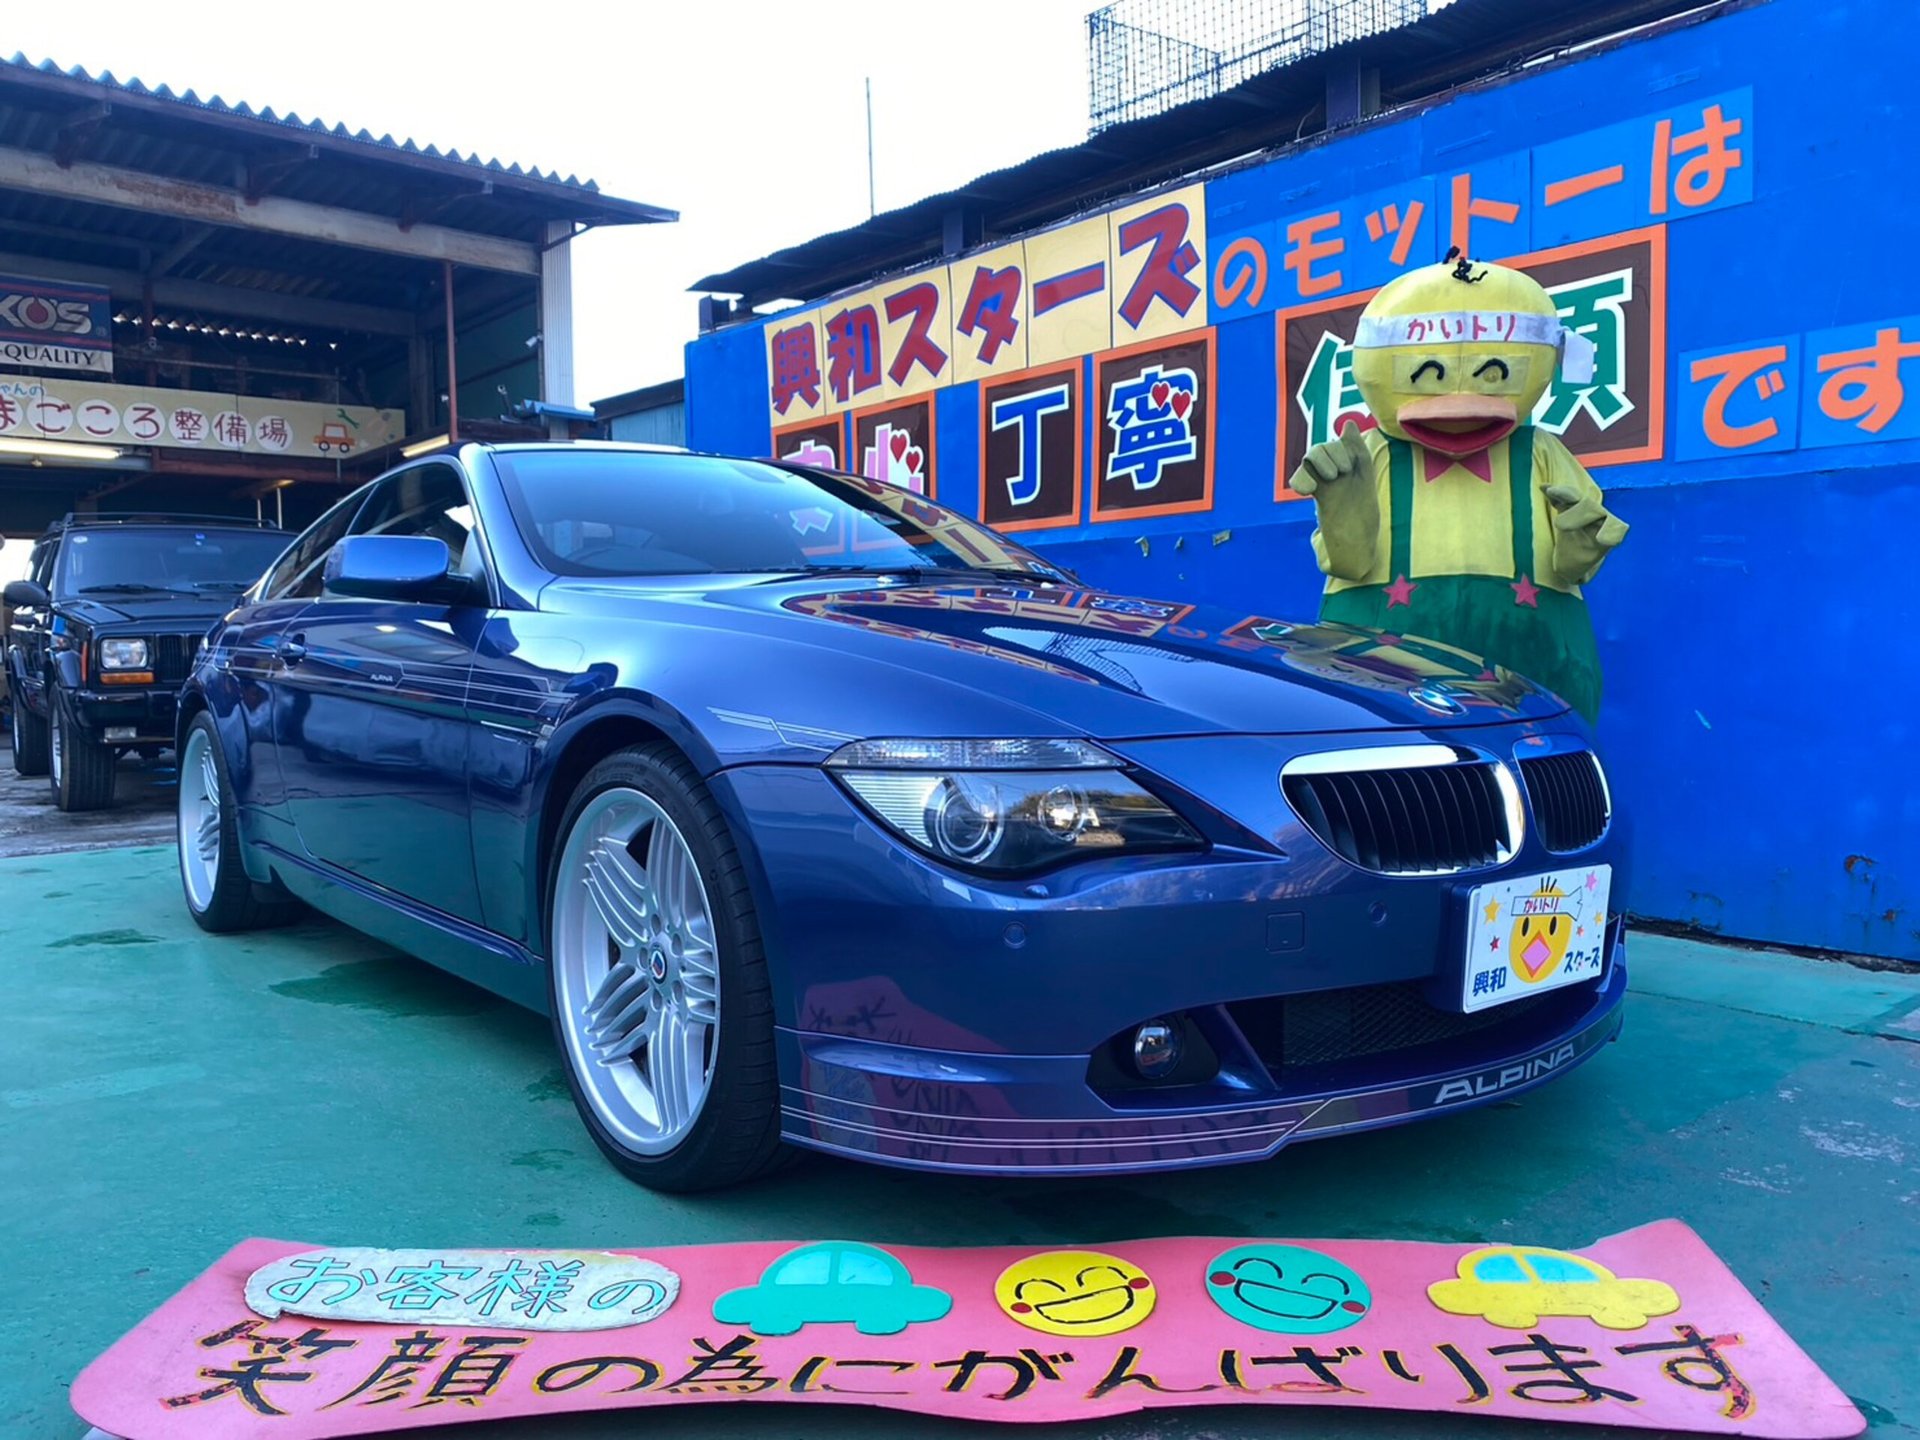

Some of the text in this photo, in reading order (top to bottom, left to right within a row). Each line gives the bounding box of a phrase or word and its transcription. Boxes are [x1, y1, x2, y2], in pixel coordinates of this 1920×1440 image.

[771, 202, 1202, 416] 興和スターズ
[1407, 314, 1517, 342] かいトリ
[1690, 327, 1920, 449] です
[991, 364, 1199, 506] 丁寧
[1471, 965, 1508, 997] 興和
[1434, 1042, 1576, 1104] ALPINA
[264, 1256, 670, 1321] お客様の
[160, 1319, 1743, 1419] 笑顔の為にがんばります
